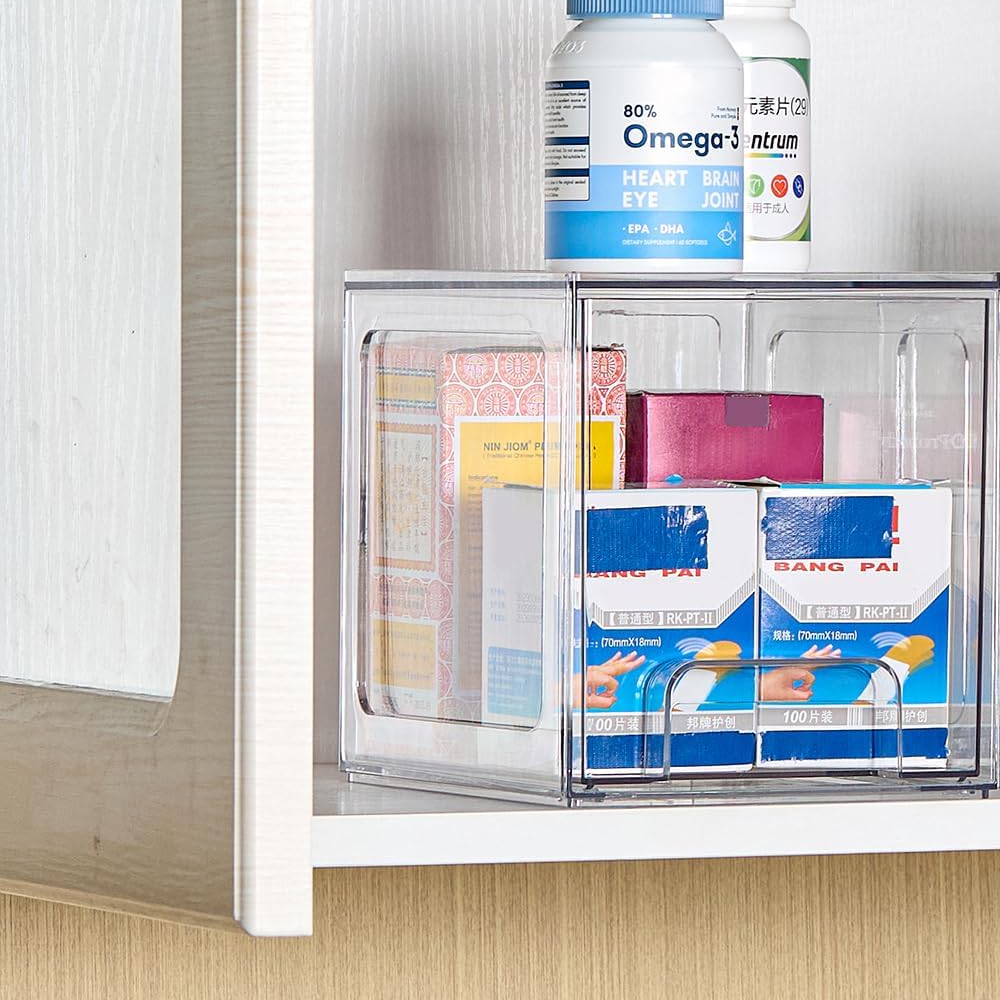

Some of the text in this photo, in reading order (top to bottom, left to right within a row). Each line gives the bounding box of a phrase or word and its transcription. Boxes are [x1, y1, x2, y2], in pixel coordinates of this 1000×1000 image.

[623, 104, 657, 118] 80%
[623, 124, 740, 157] Omega-3
[622, 169, 740, 187] HEART BRAIN
[622, 191, 740, 209] EYE JOINT
[628, 223, 685, 234] EPA DHA
[483, 442, 501, 451] NIN
[773, 561, 899, 573] BANG PAI
[863, 605, 909, 620] RK-PT-II
[600, 636, 662, 649] (70mmX18mm)
[797, 629, 858, 642] (70mmX18mm)
[783, 709, 834, 725] 100片装
